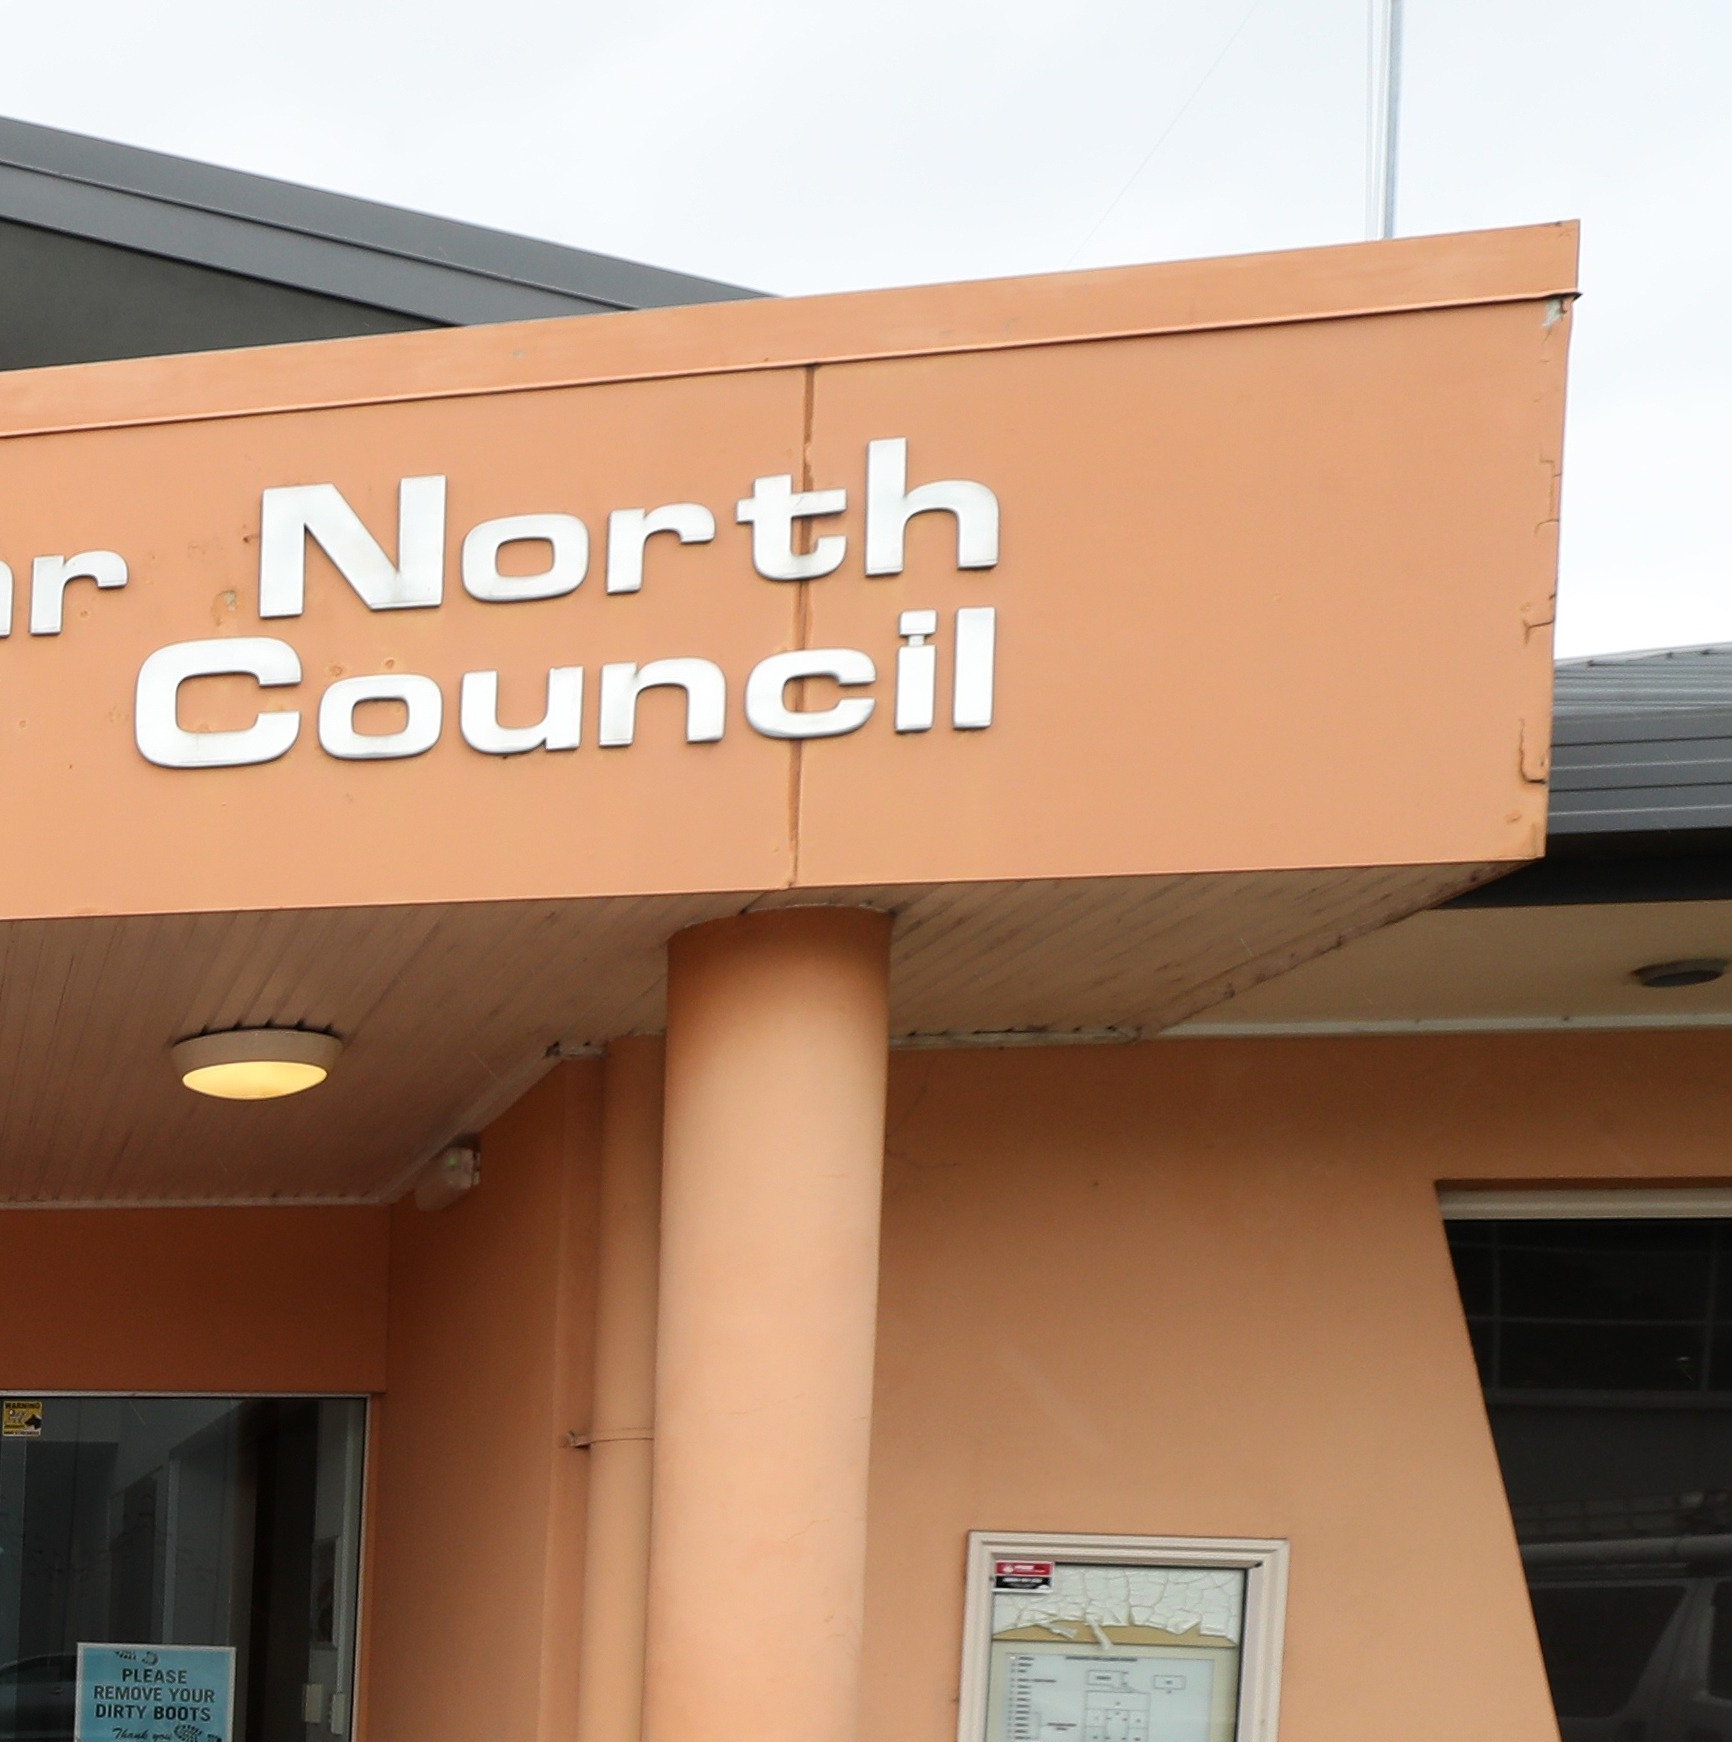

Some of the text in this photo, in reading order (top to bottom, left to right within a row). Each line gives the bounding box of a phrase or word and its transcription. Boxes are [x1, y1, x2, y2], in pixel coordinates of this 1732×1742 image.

[258, 437, 1000, 618] North
[133, 606, 997, 769] Council
[121, 1668, 188, 1684] PLEASE
[93, 1685, 215, 1703] REMOVE YOUR
[95, 1704, 211, 1722] DIRTY BOOTS
[112, 1727, 172, 1742] Thank you
